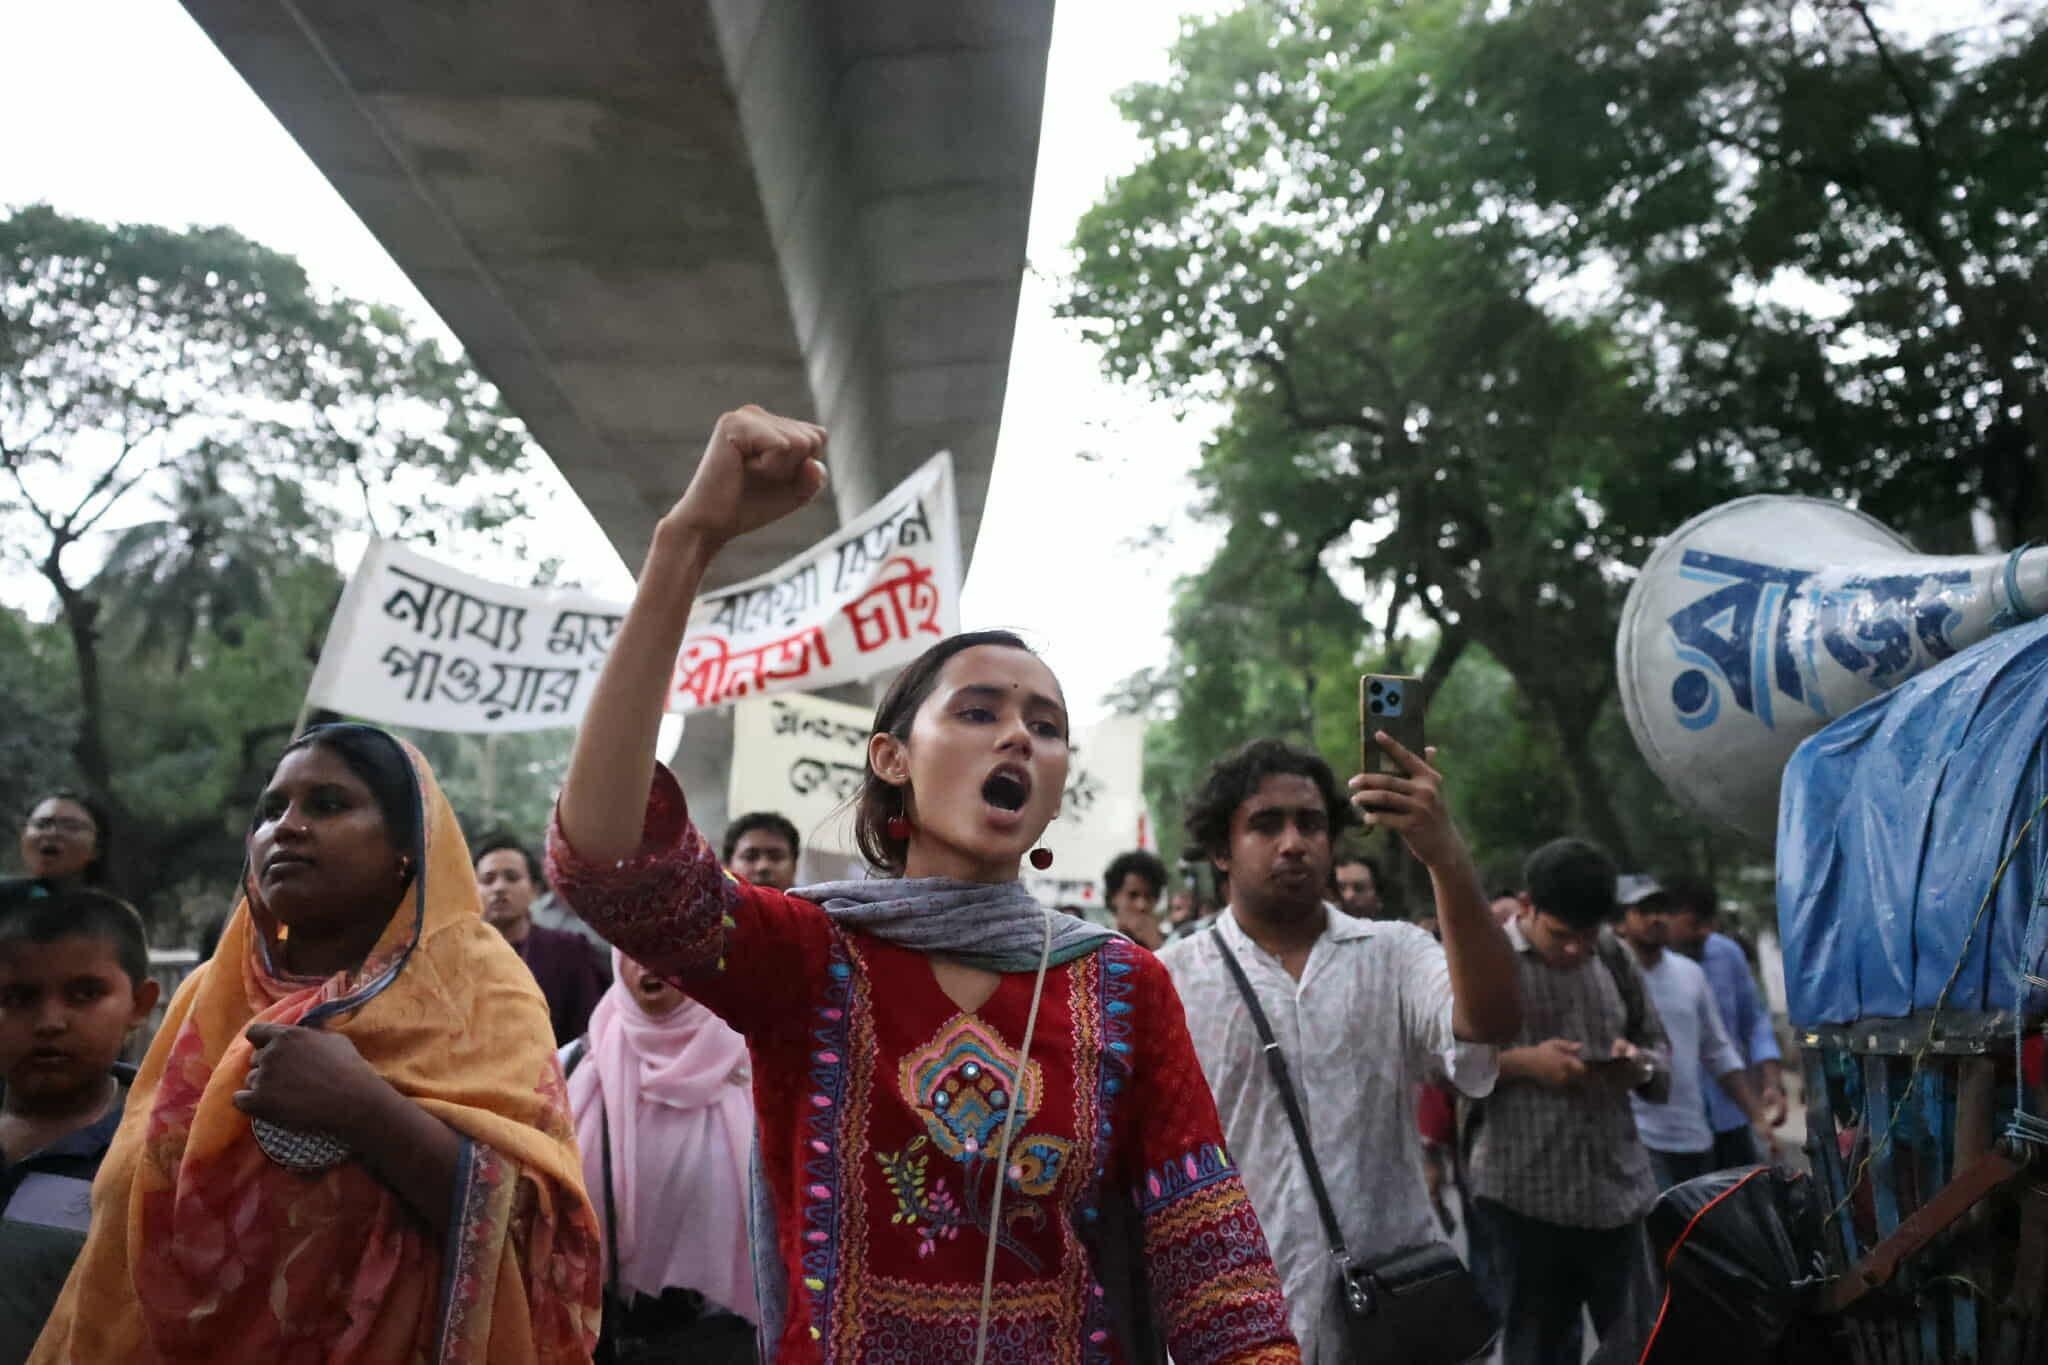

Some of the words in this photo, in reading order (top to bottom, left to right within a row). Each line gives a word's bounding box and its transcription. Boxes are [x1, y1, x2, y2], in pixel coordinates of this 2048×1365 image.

[382, 646, 581, 720] পাওয়ার
[664, 626, 832, 712] ধীনতা
[842, 556, 942, 652] চাই
[383, 565, 528, 652] ন্যায্য
